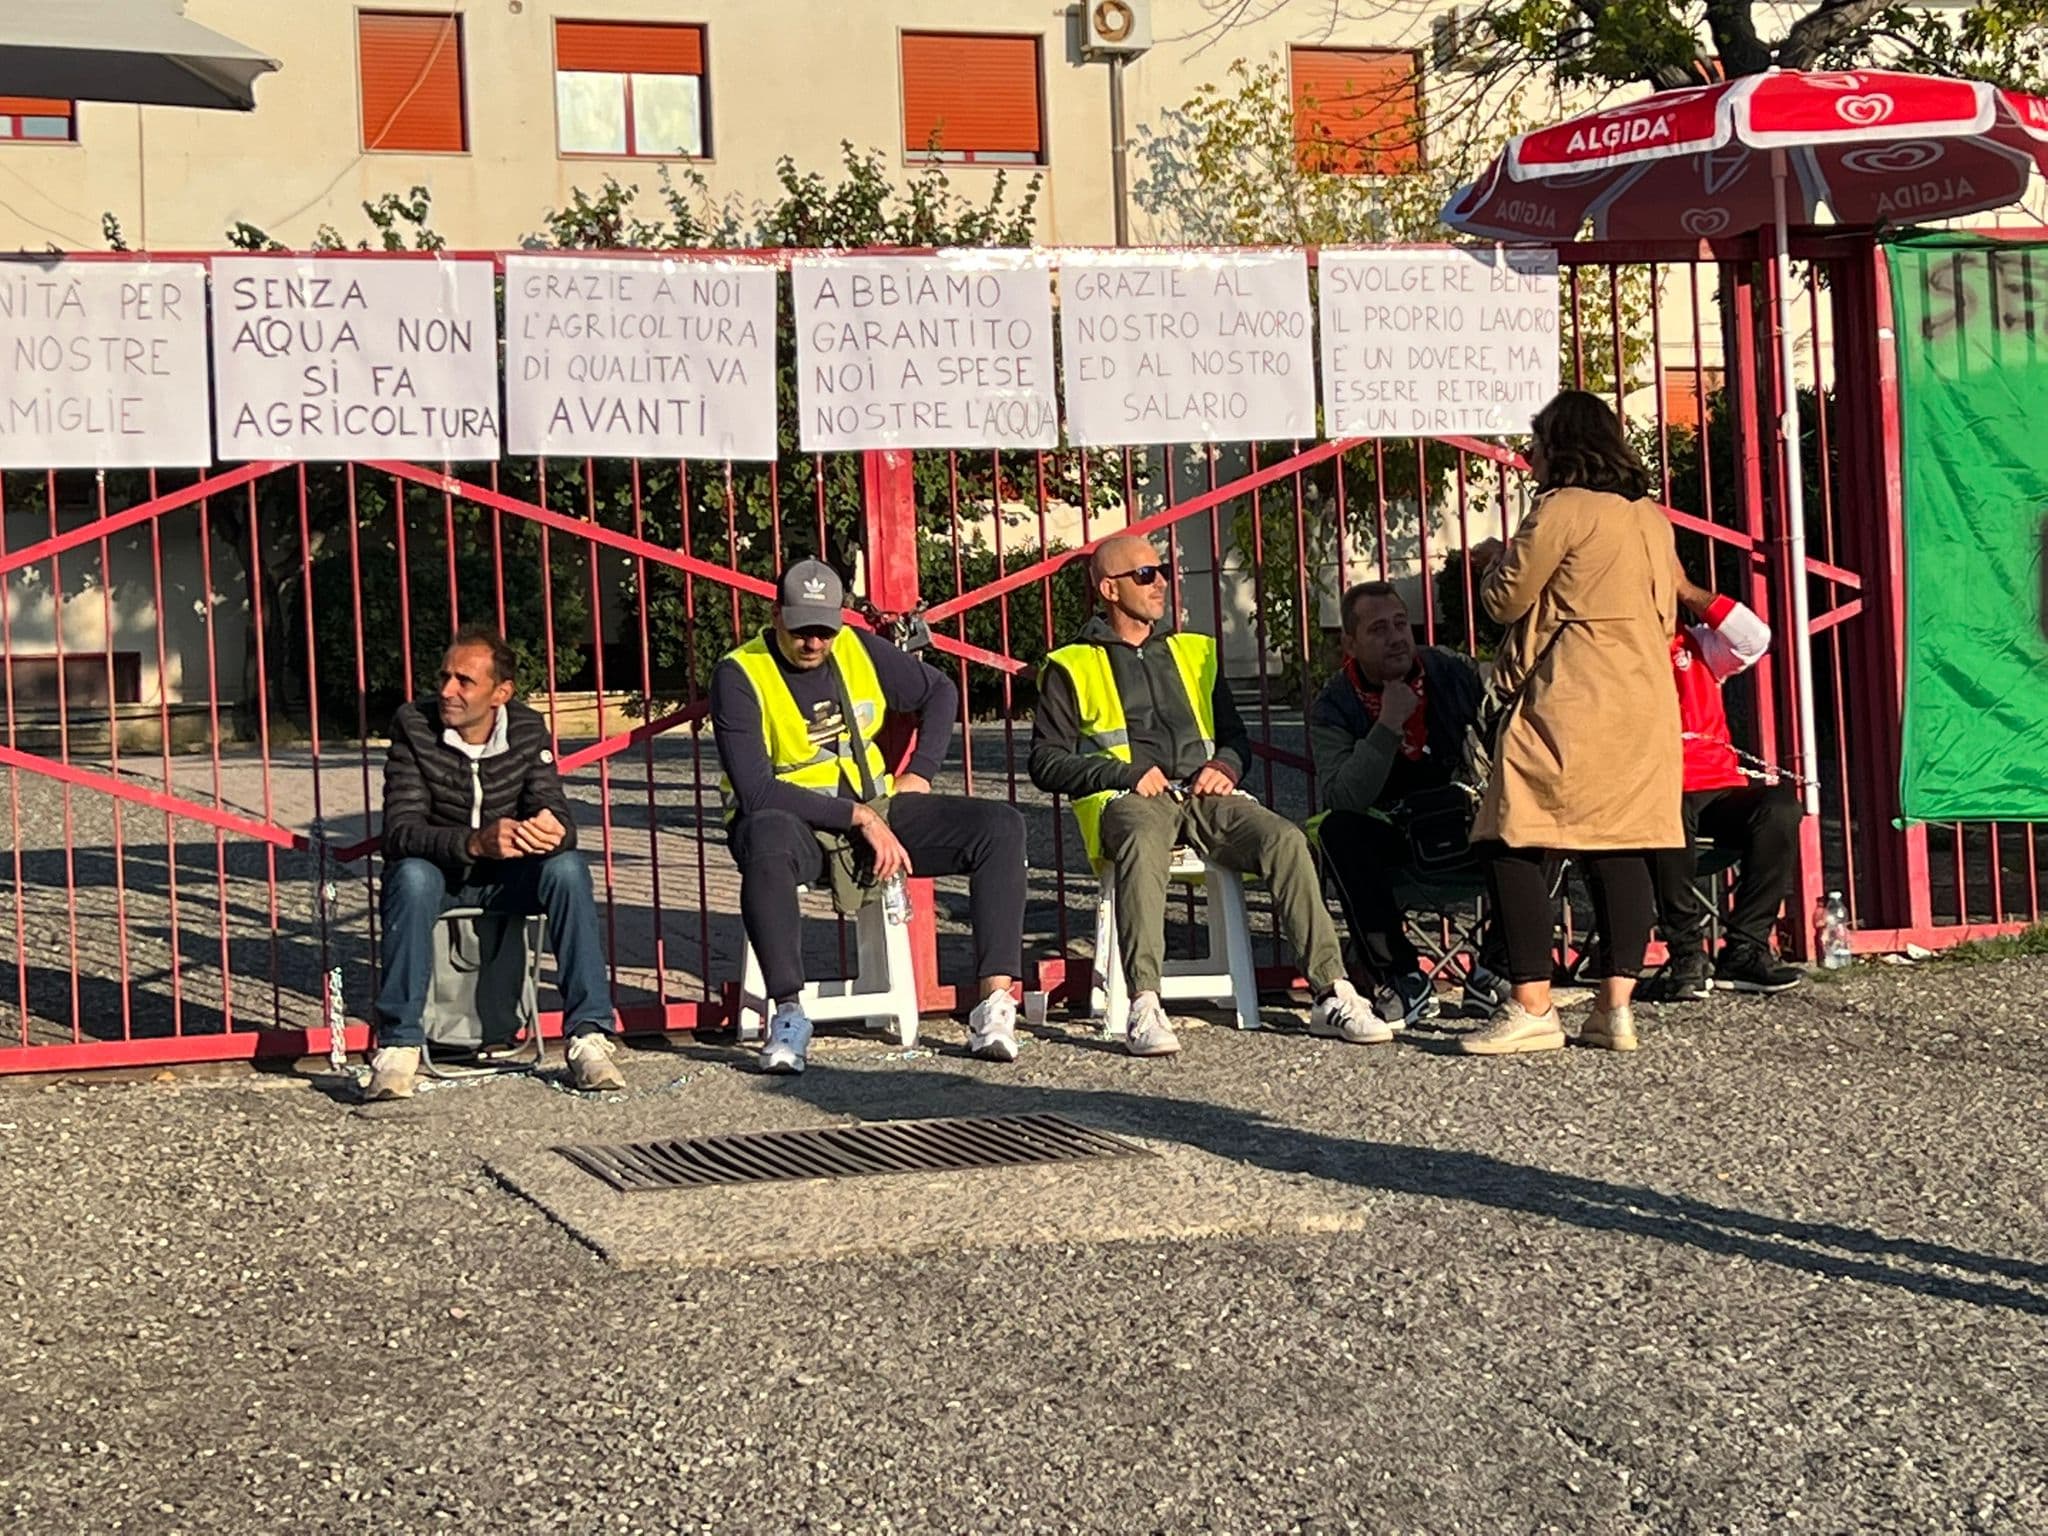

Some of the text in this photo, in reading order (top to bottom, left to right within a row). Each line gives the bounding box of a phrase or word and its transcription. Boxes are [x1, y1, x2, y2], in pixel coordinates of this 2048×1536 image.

[1566, 115, 1670, 154] ALGIDA
[233, 277, 368, 310] SENZA
[523, 271, 635, 301] GRAZIE
[652, 277, 677, 304] A
[814, 268, 1001, 310] ABBIAMO
[1075, 269, 1253, 301] GRAZIE AL
[1330, 264, 1548, 294] SVOLGERE BENE
[121, 283, 182, 321] PER
[812, 313, 1032, 353] GARANTITO
[1078, 311, 1305, 345] NOSTRO LAVORO
[1332, 305, 1555, 333] IL PROPRIO LAVORO
[232, 316, 472, 358] ACQUA NON
[15, 335, 171, 375] NOSTRE
[707, 357, 748, 385] VA
[1079, 350, 1291, 382] ED AL NOSTRO
[1363, 345, 1393, 370] UN
[1407, 345, 1497, 374] DOVERE,
[1508, 345, 1542, 371] MA
[371, 366, 417, 398] FA
[900, 358, 923, 389] A
[938, 357, 1034, 387] SPESE
[1124, 391, 1248, 422] SALARIO
[1334, 379, 1543, 403] ESSERE RETRIBUITI
[0, 387, 145, 434] MIGLIE
[233, 400, 498, 439] AGRICOLTURA
[548, 395, 706, 435] AVANTI
[817, 401, 948, 435] NOSTRE
[1366, 408, 1397, 430] UN
